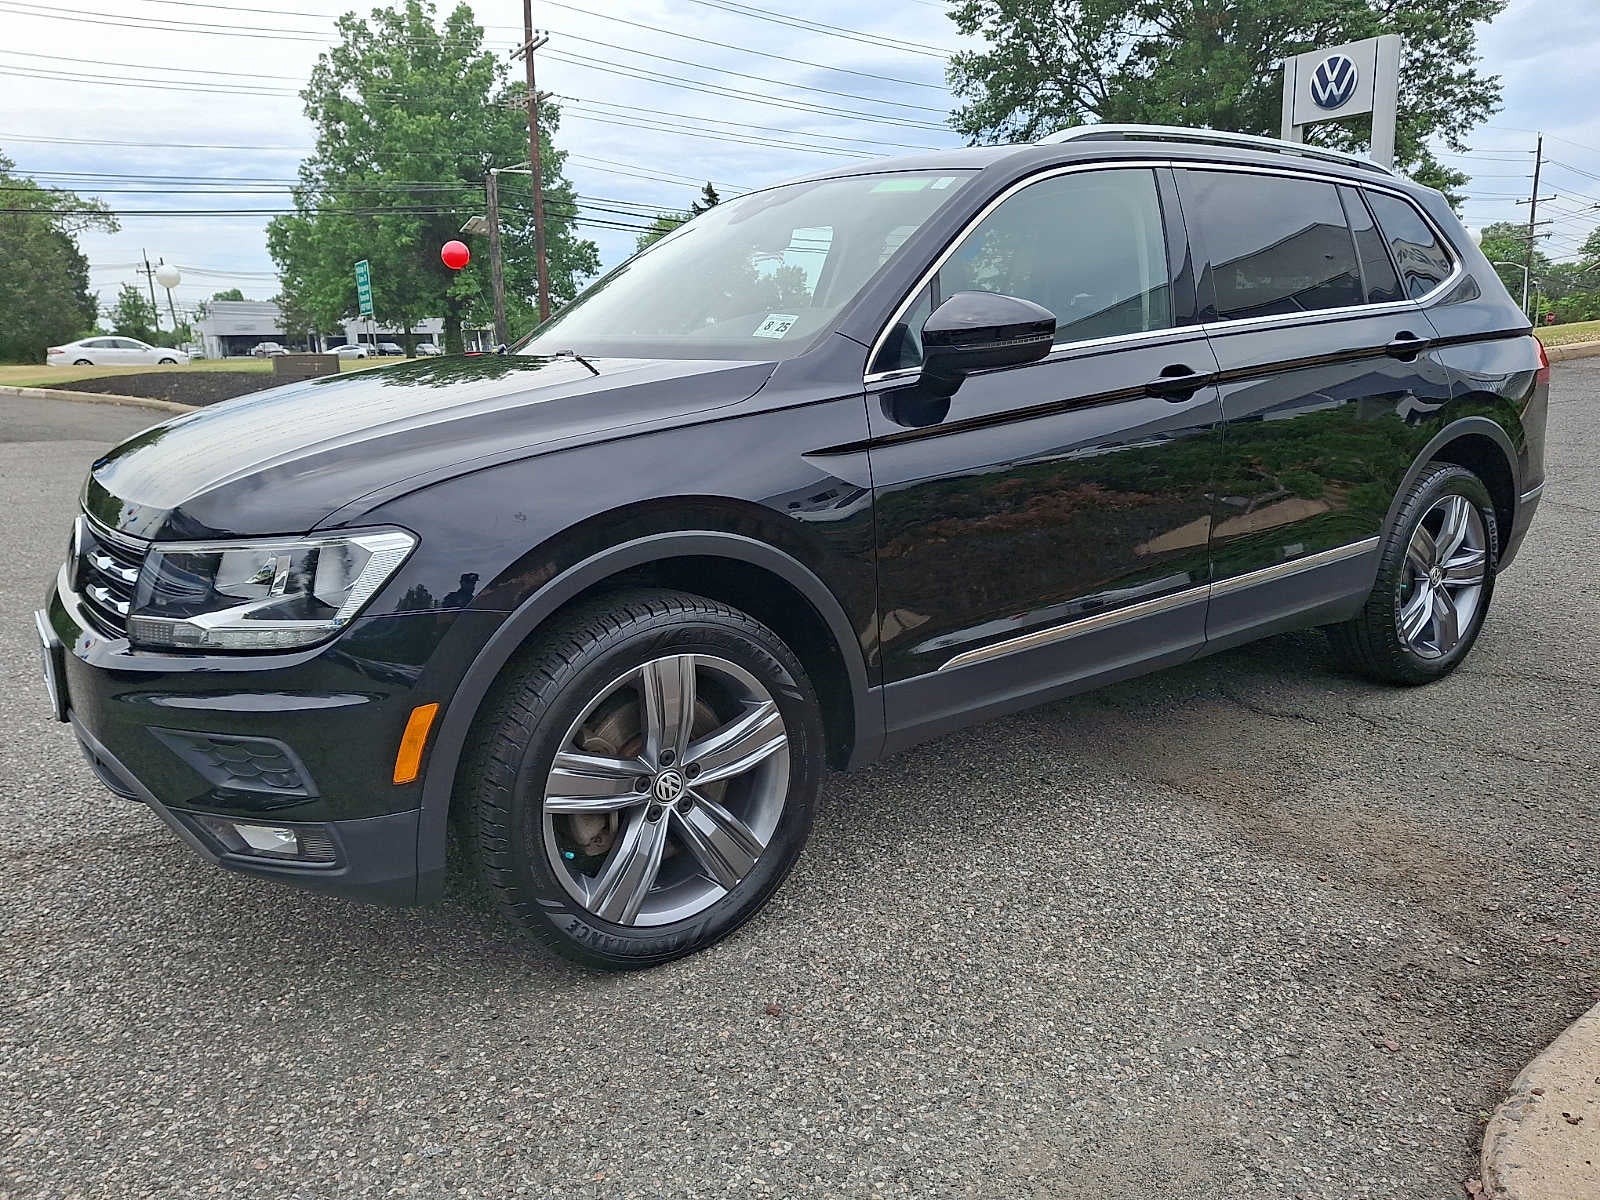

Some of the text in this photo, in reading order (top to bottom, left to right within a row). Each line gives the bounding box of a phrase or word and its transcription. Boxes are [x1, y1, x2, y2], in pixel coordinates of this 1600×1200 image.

[1310, 55, 1358, 110] VW
[774, 321, 791, 332] 25
[656, 772, 681, 801] VW
